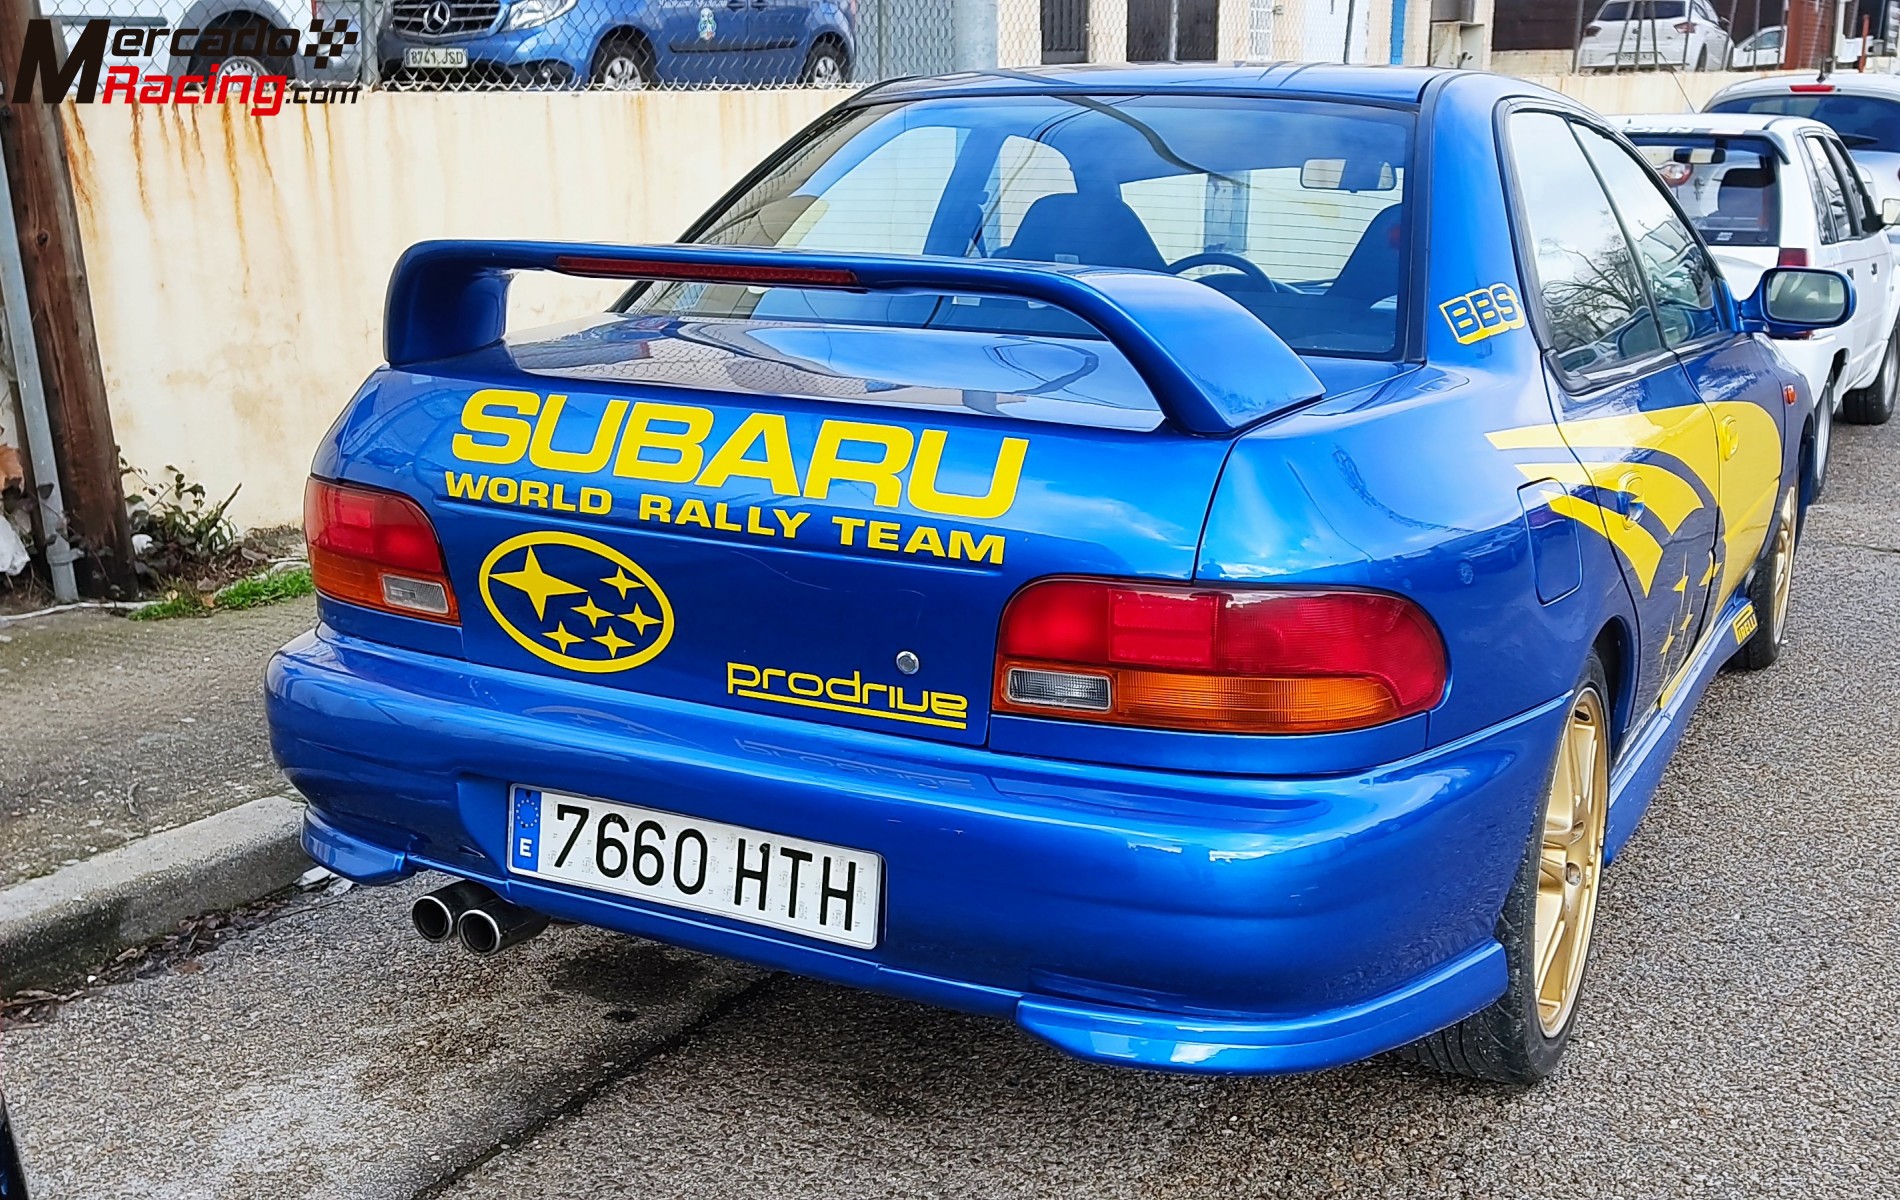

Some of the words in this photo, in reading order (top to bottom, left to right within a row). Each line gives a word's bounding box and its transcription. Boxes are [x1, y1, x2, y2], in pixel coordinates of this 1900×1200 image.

[1440, 283, 1524, 343] BBS
[452, 388, 1029, 519] SUBARU
[445, 471, 612, 515] WORLD
[638, 493, 810, 539] RALLY
[832, 515, 1006, 565] TEAM
[726, 661, 969, 719] prodrive
[518, 837, 533, 858] E
[553, 802, 709, 896] 7660
[732, 837, 858, 932] HTH
